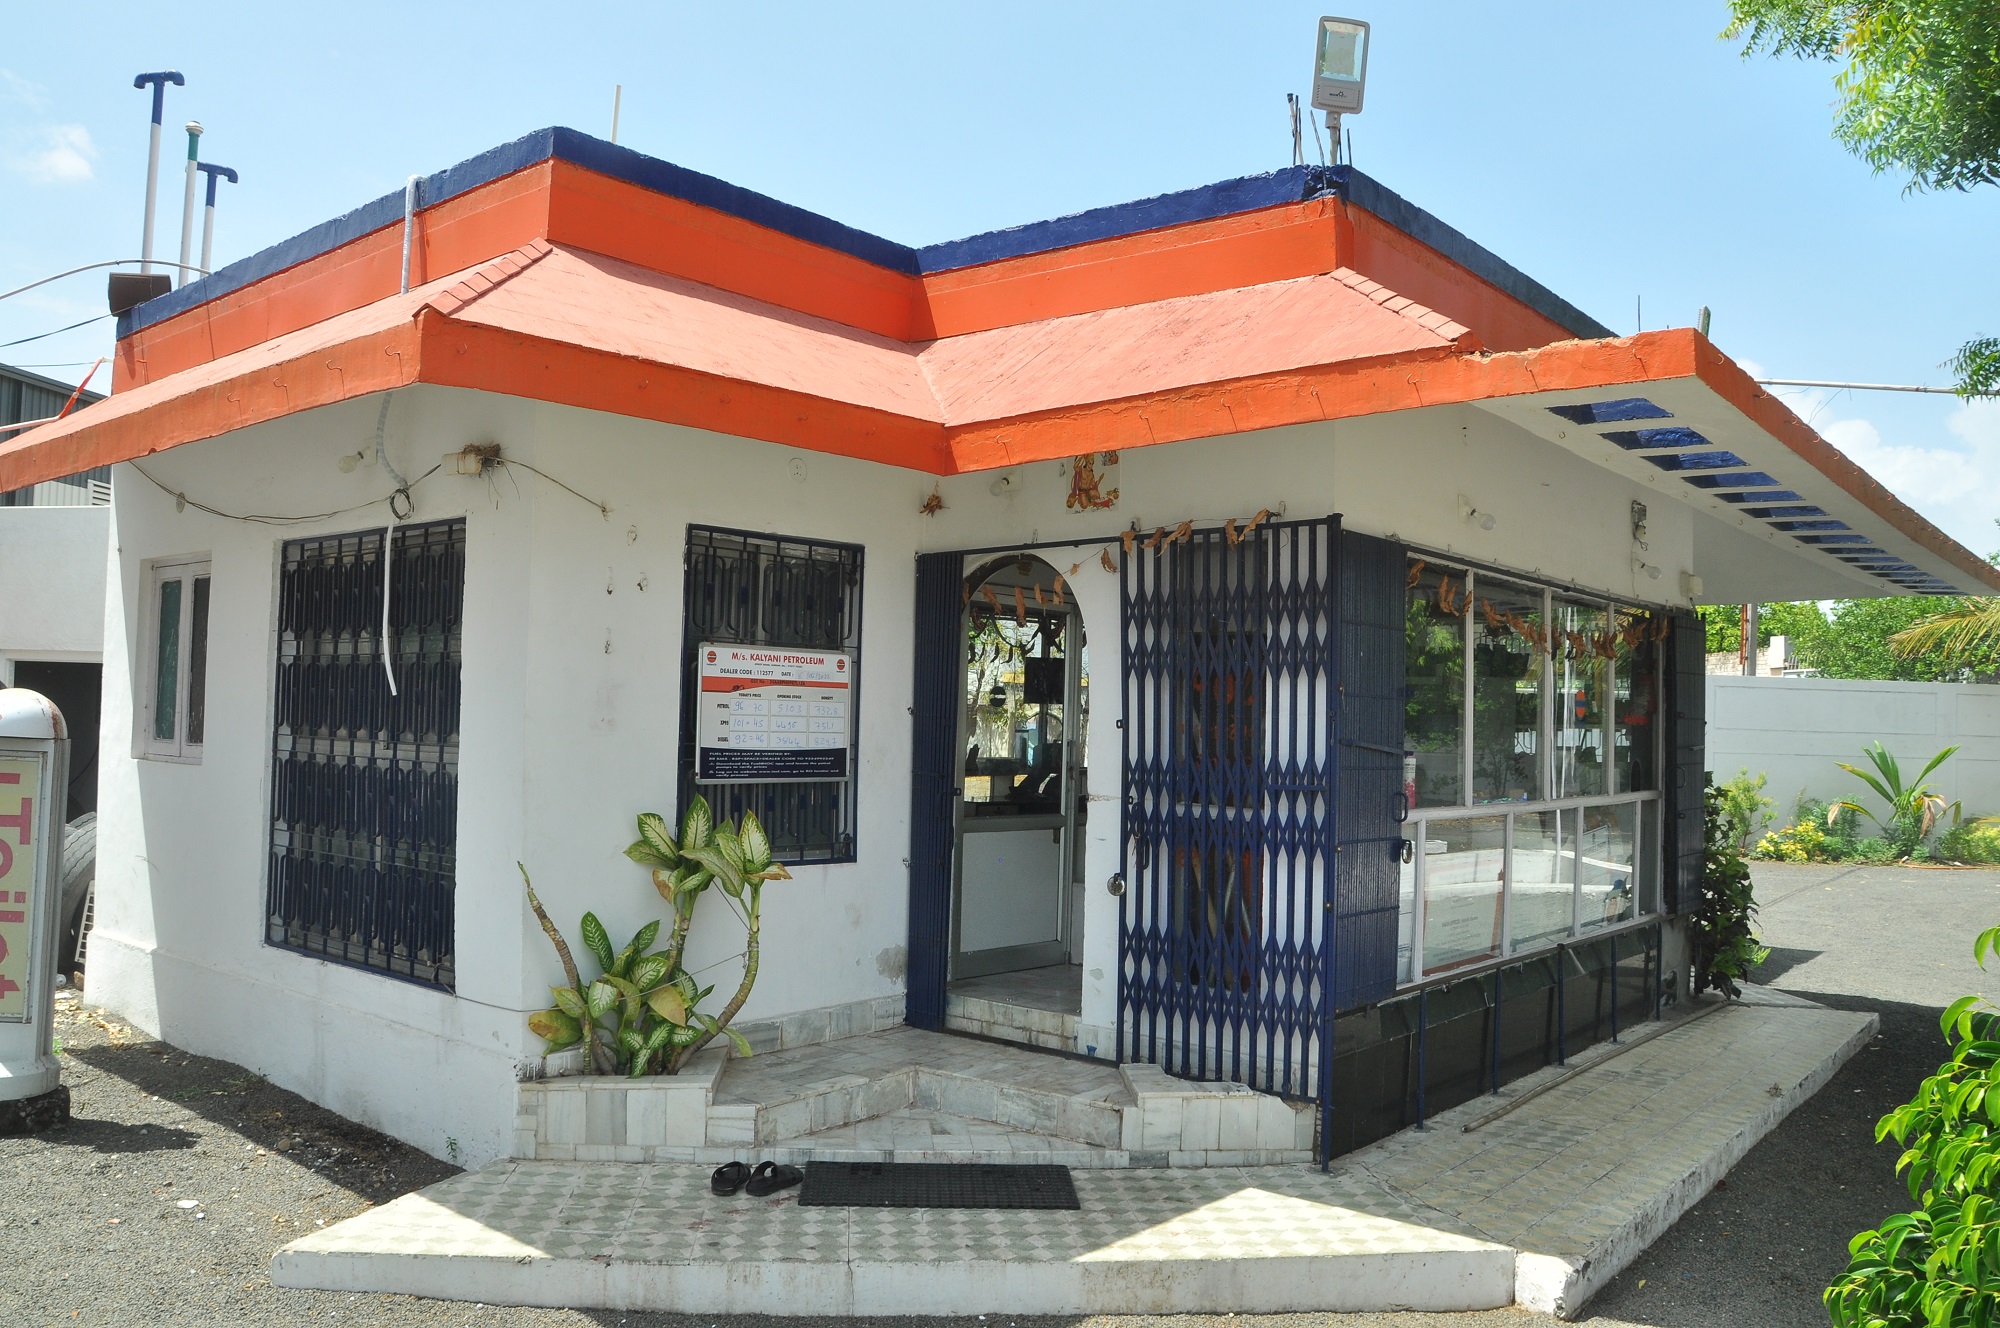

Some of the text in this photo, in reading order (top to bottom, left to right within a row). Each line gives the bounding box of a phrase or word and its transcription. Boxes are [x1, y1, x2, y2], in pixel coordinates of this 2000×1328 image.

[731, 652, 748, 661] M/s.
[750, 653, 781, 663] KALYANI
[783, 655, 825, 666] PETROLEUM
